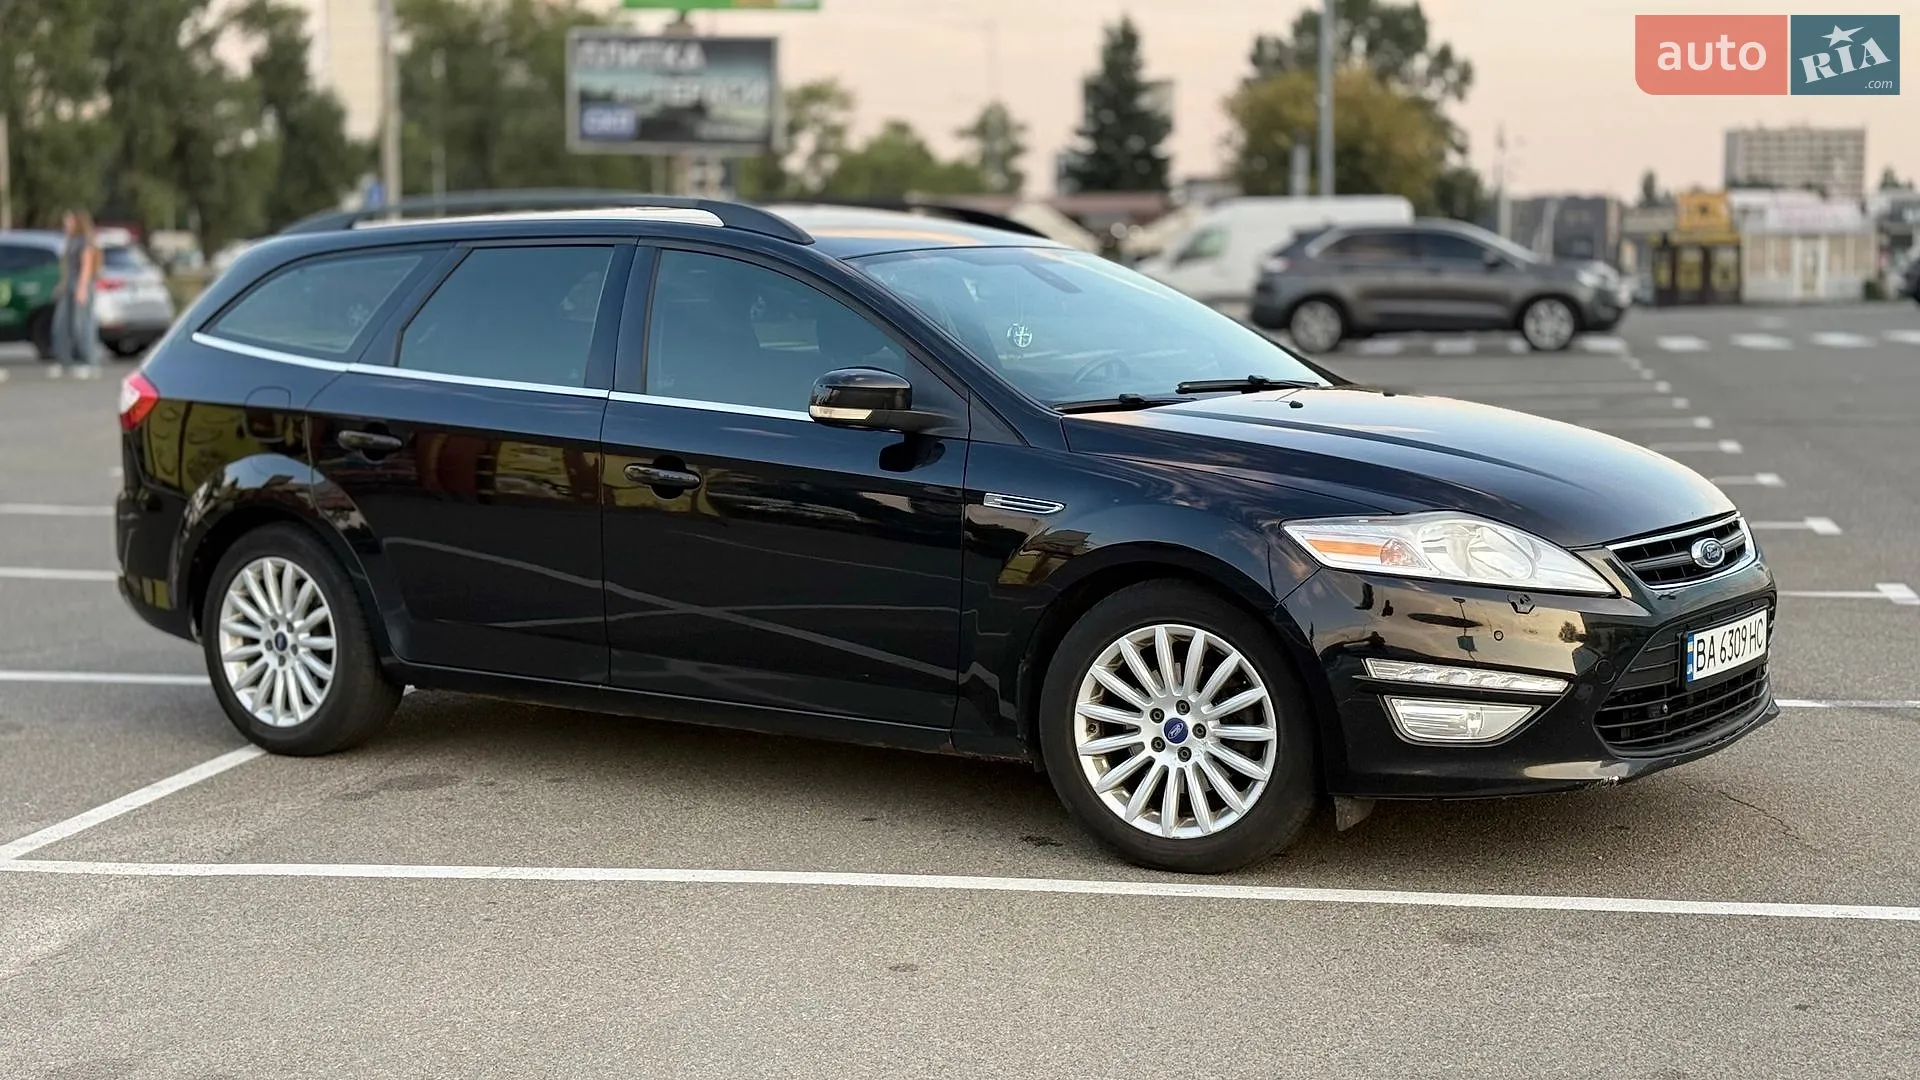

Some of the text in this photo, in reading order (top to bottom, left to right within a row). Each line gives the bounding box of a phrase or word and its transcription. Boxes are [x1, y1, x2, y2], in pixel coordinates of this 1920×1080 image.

[1696, 618, 1763, 672] BA 6309 HC
